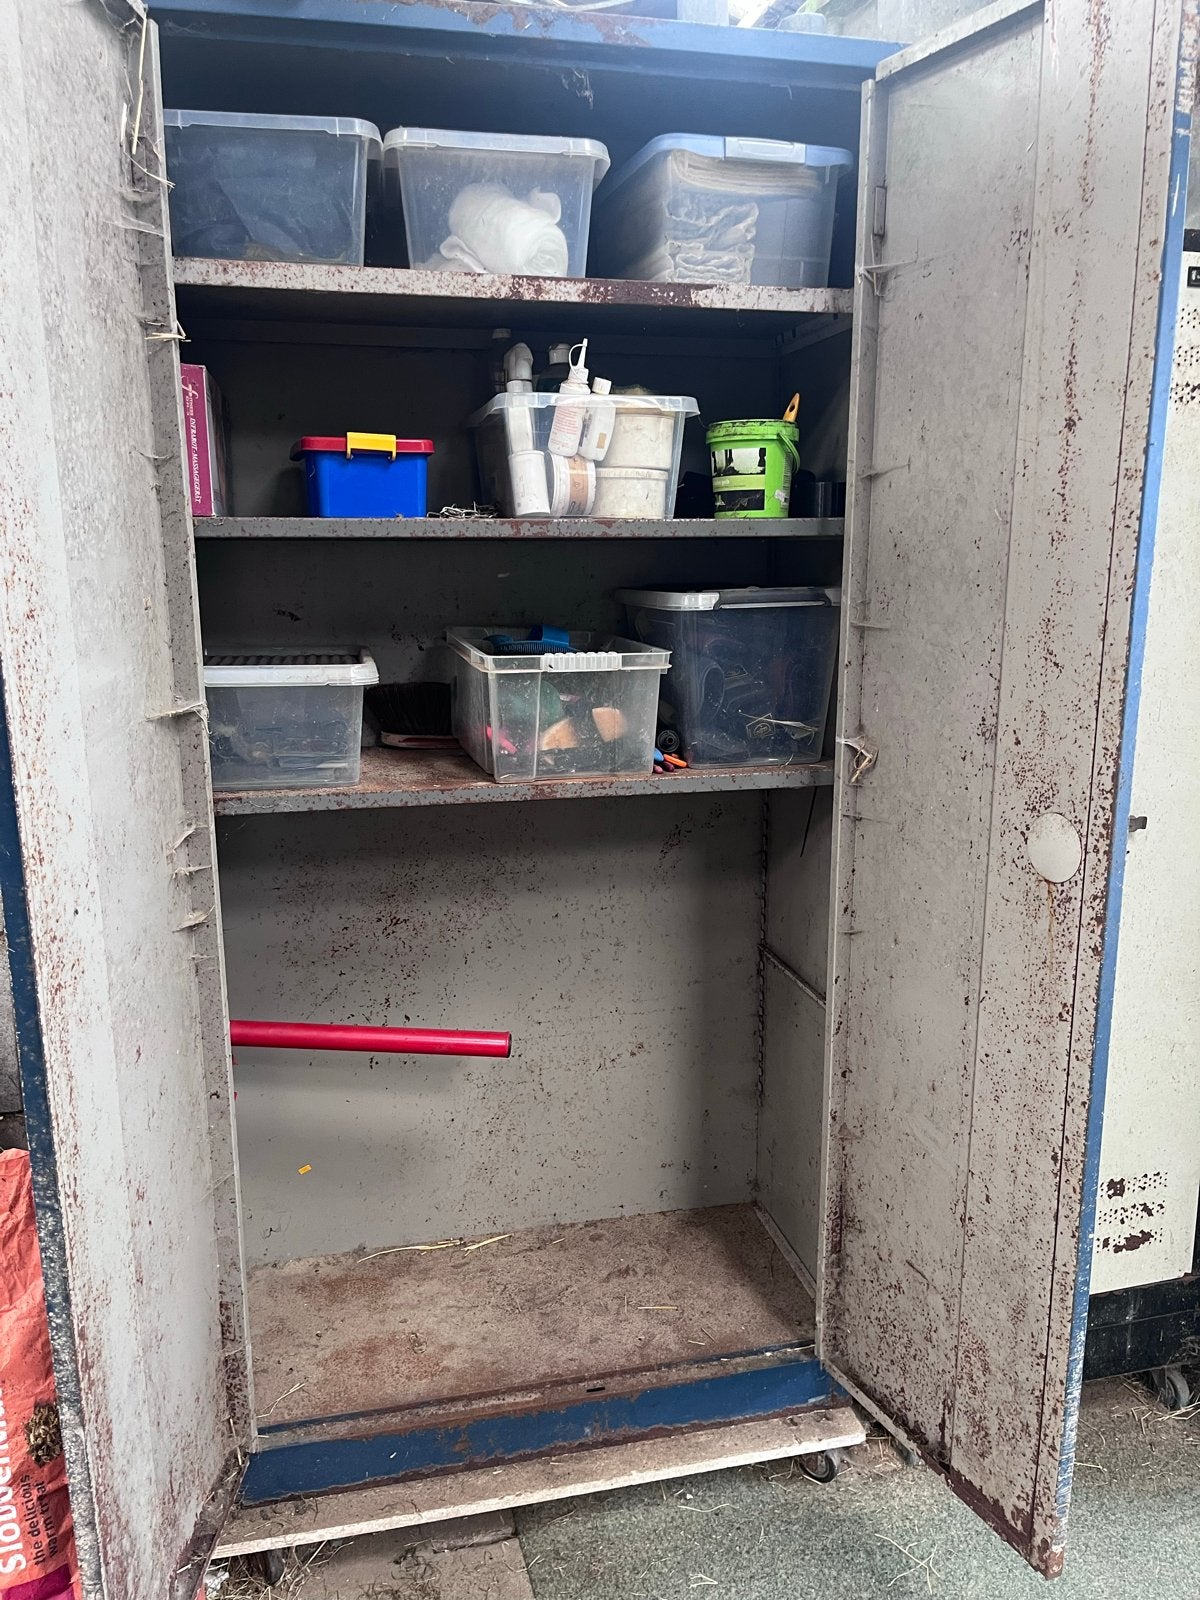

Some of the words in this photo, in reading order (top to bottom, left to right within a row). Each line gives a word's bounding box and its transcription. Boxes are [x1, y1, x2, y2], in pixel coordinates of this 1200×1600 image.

[20, 1474, 41, 1538] delicious
[33, 1540, 46, 1566] the
[43, 1516, 59, 1558] warm
